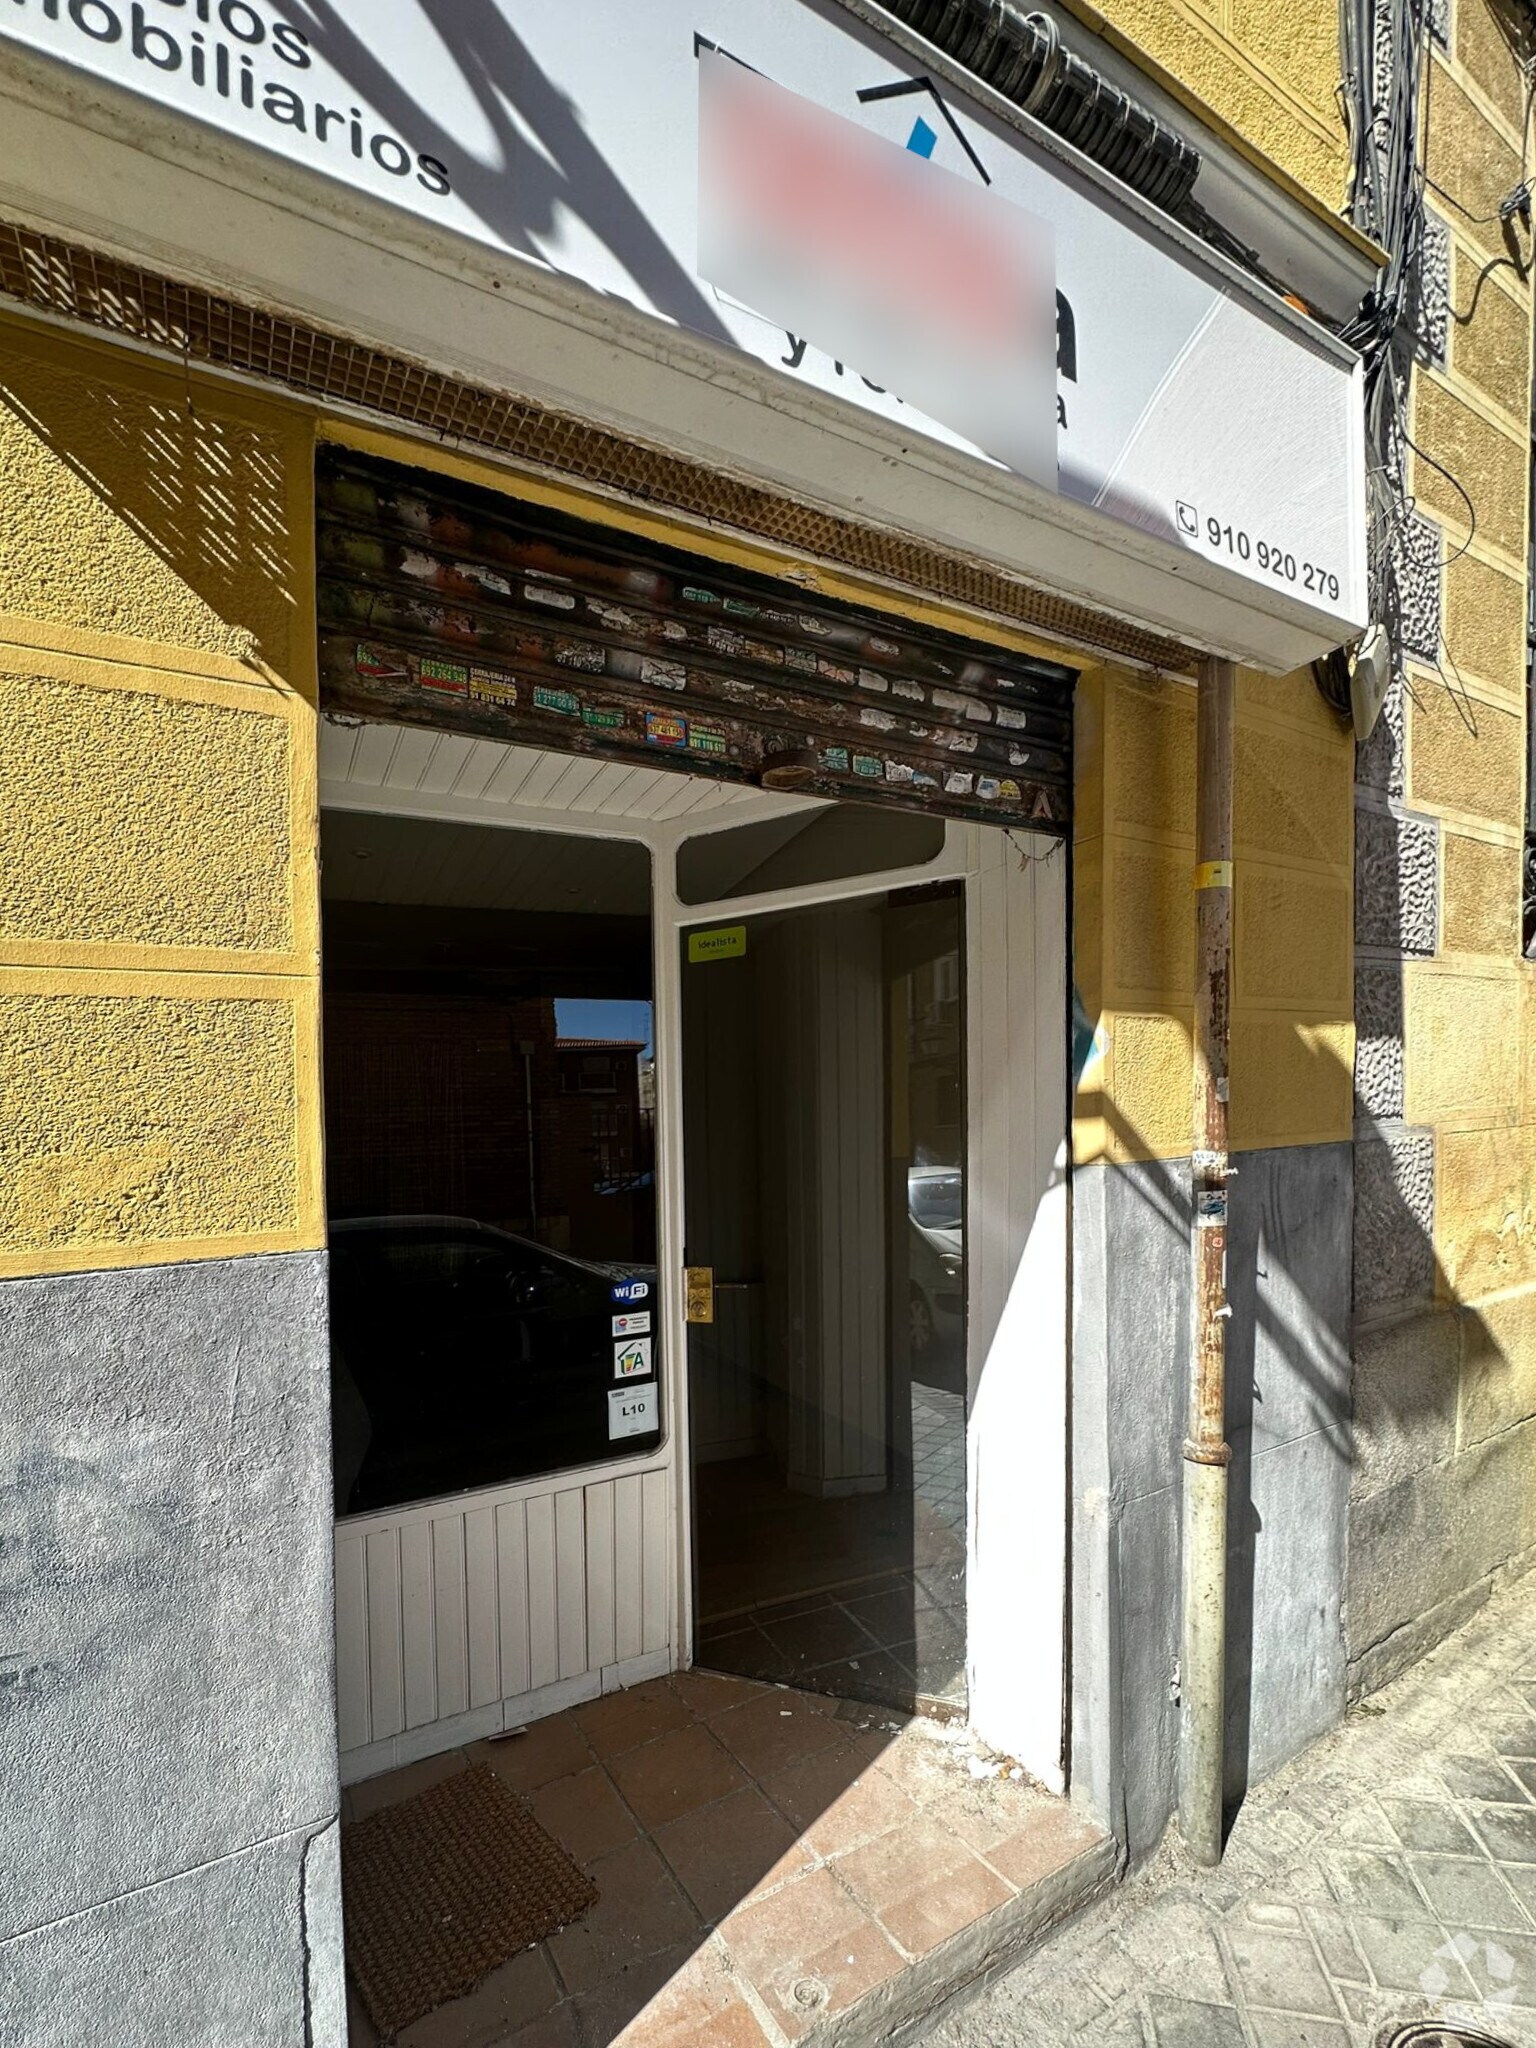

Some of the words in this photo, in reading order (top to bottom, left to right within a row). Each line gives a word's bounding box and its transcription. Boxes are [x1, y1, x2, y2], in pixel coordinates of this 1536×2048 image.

[1207, 517, 1250, 560] 910
[1256, 541, 1296, 582] 920
[1303, 562, 1339, 601] 279
[622, 1403, 646, 1417] L10
